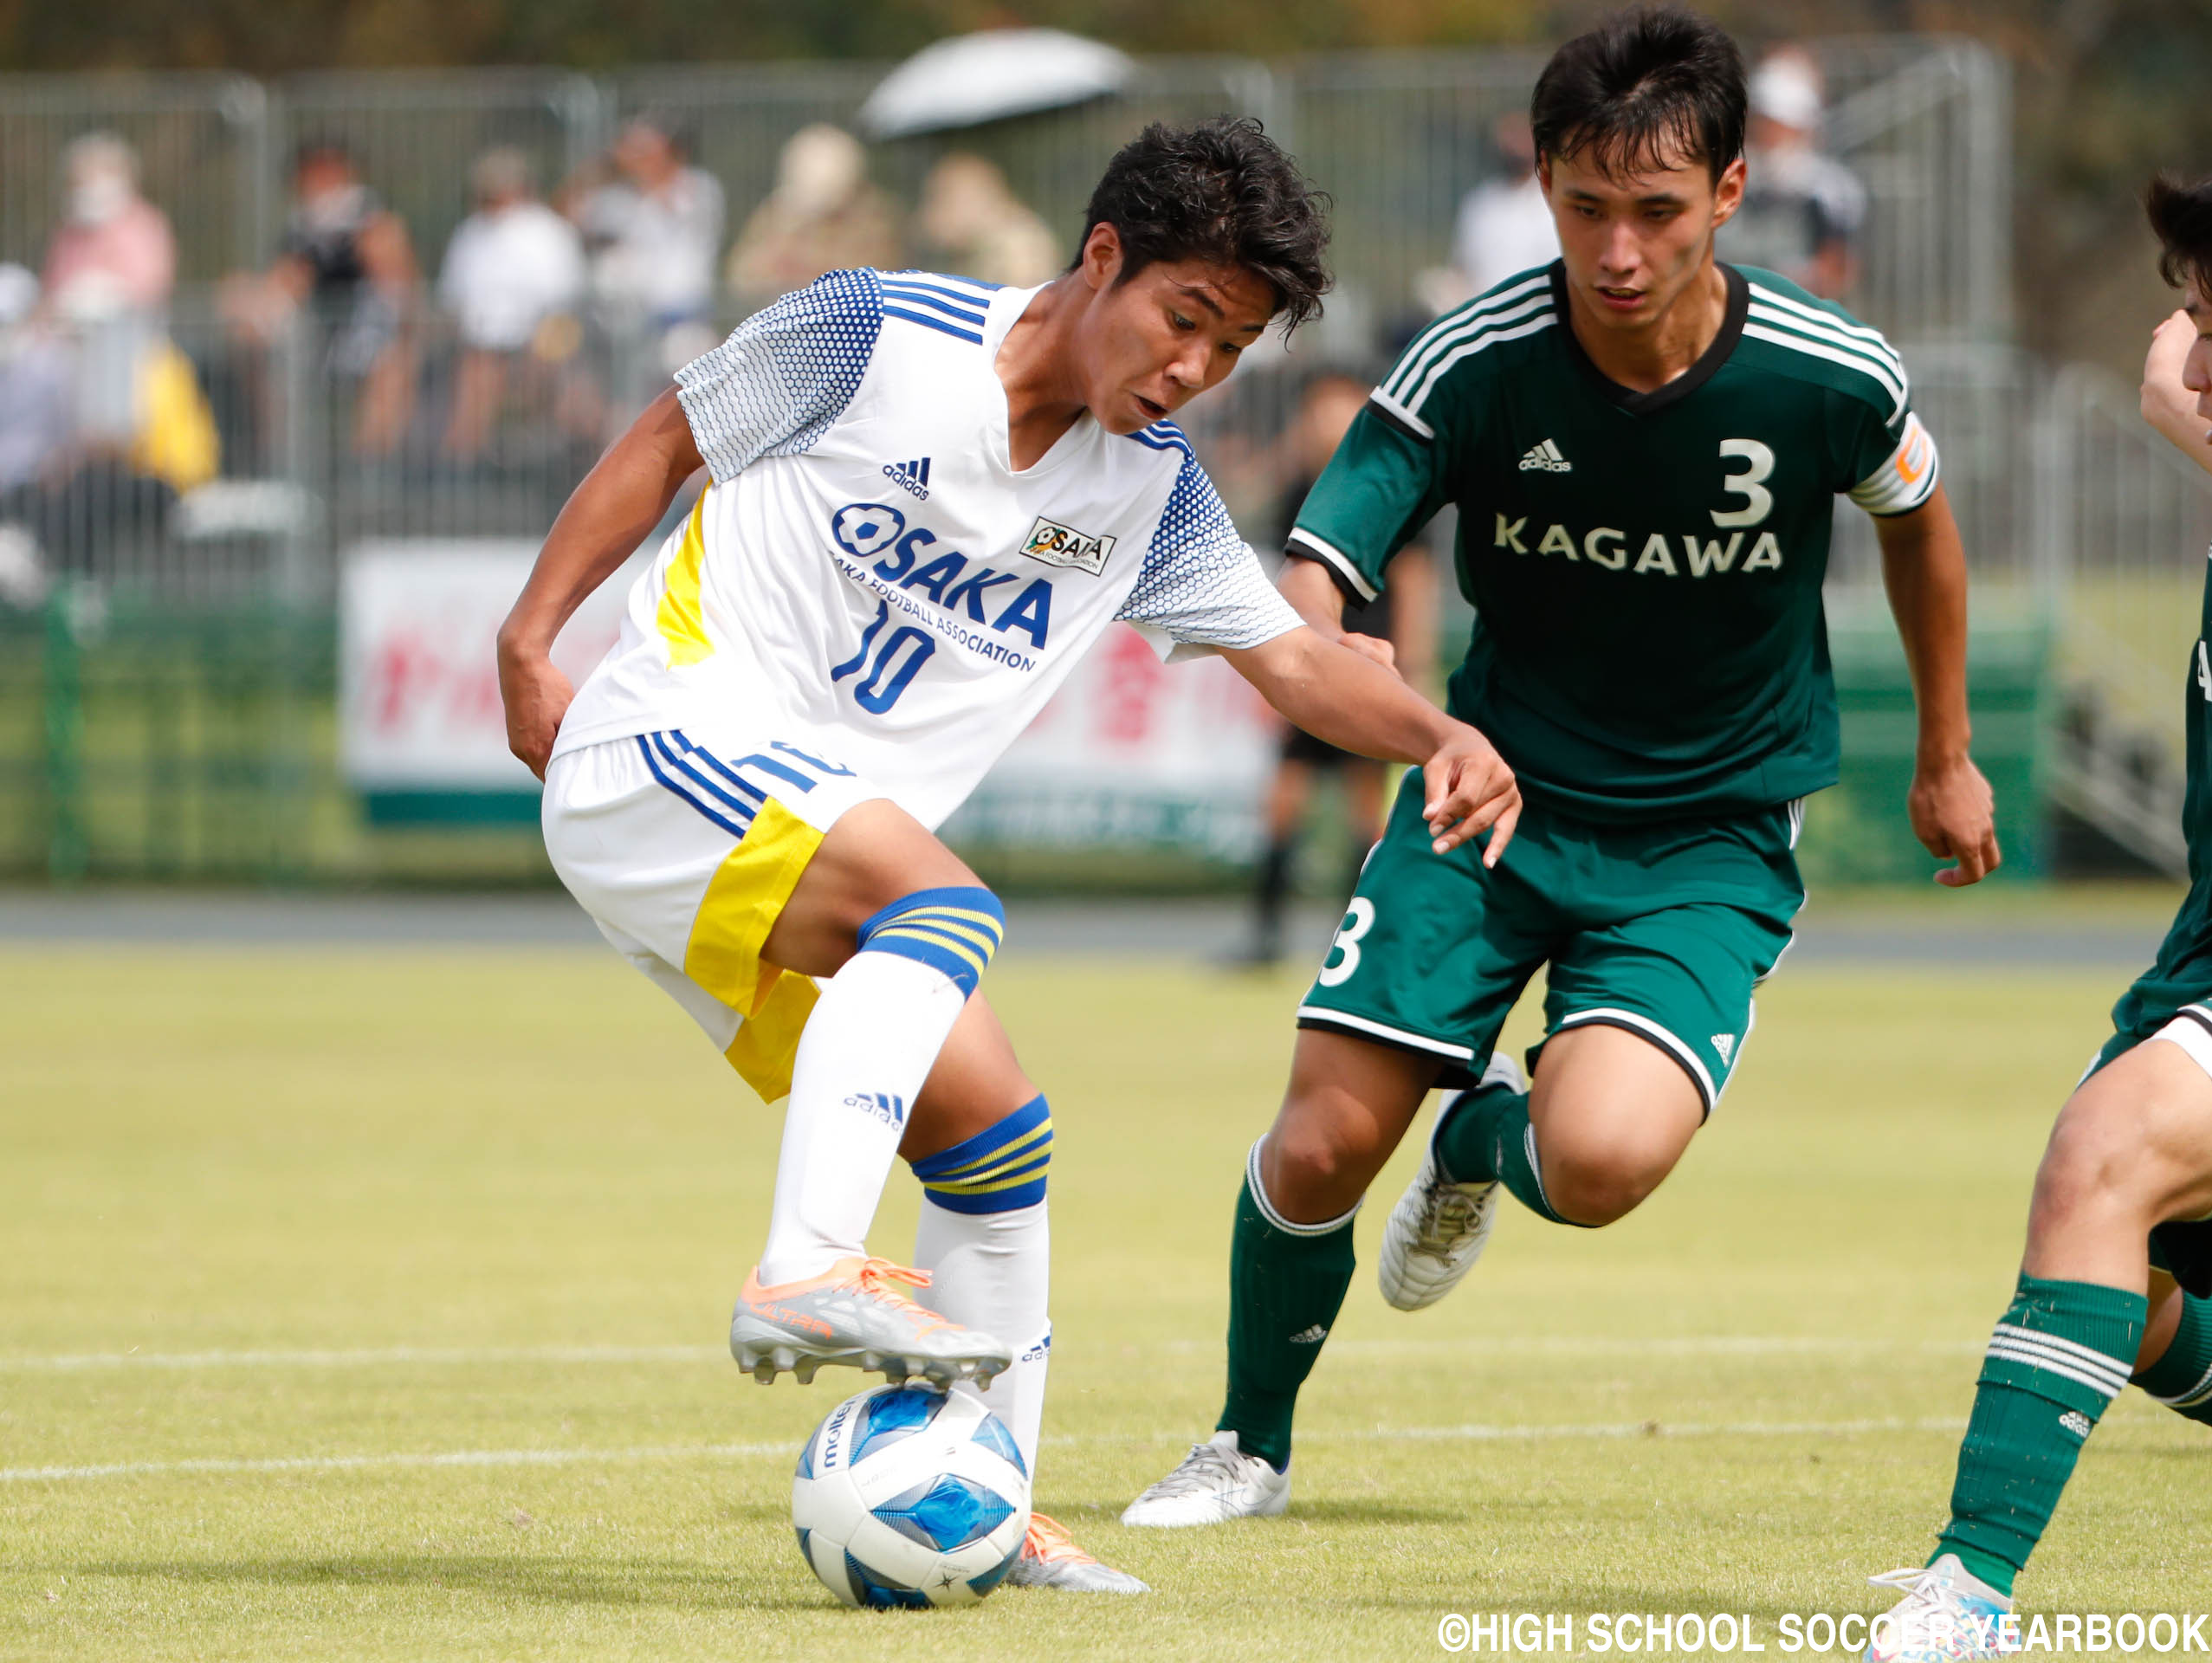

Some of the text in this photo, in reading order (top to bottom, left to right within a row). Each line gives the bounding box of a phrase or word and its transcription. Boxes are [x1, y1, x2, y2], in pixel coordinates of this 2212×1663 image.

[883, 464, 929, 501] adidas
[1518, 456, 1572, 472] adidas
[1711, 438, 1775, 529] 3
[831, 503, 1052, 650] OSAKA
[1495, 514, 1783, 578] KAGAWA
[829, 550, 1036, 672] AKA FOOTBALL ASSOCIATION
[831, 598, 936, 715] 10
[1319, 896, 1375, 987] 3
